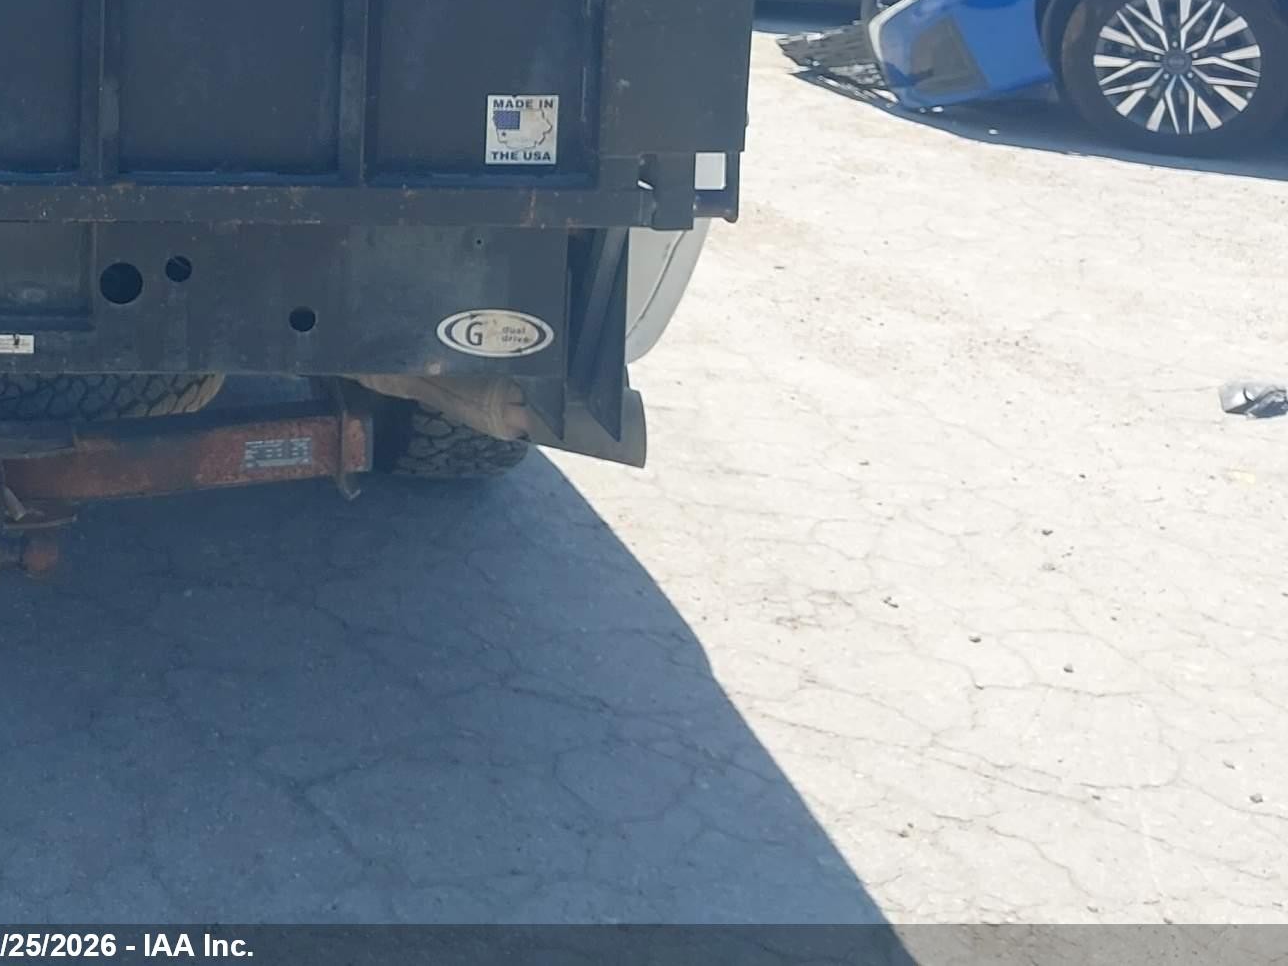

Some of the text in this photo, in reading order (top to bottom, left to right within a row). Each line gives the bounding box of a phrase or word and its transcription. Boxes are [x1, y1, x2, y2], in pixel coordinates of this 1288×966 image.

[492, 98, 554, 109] MADE IN
[491, 151, 551, 161] THE USA
